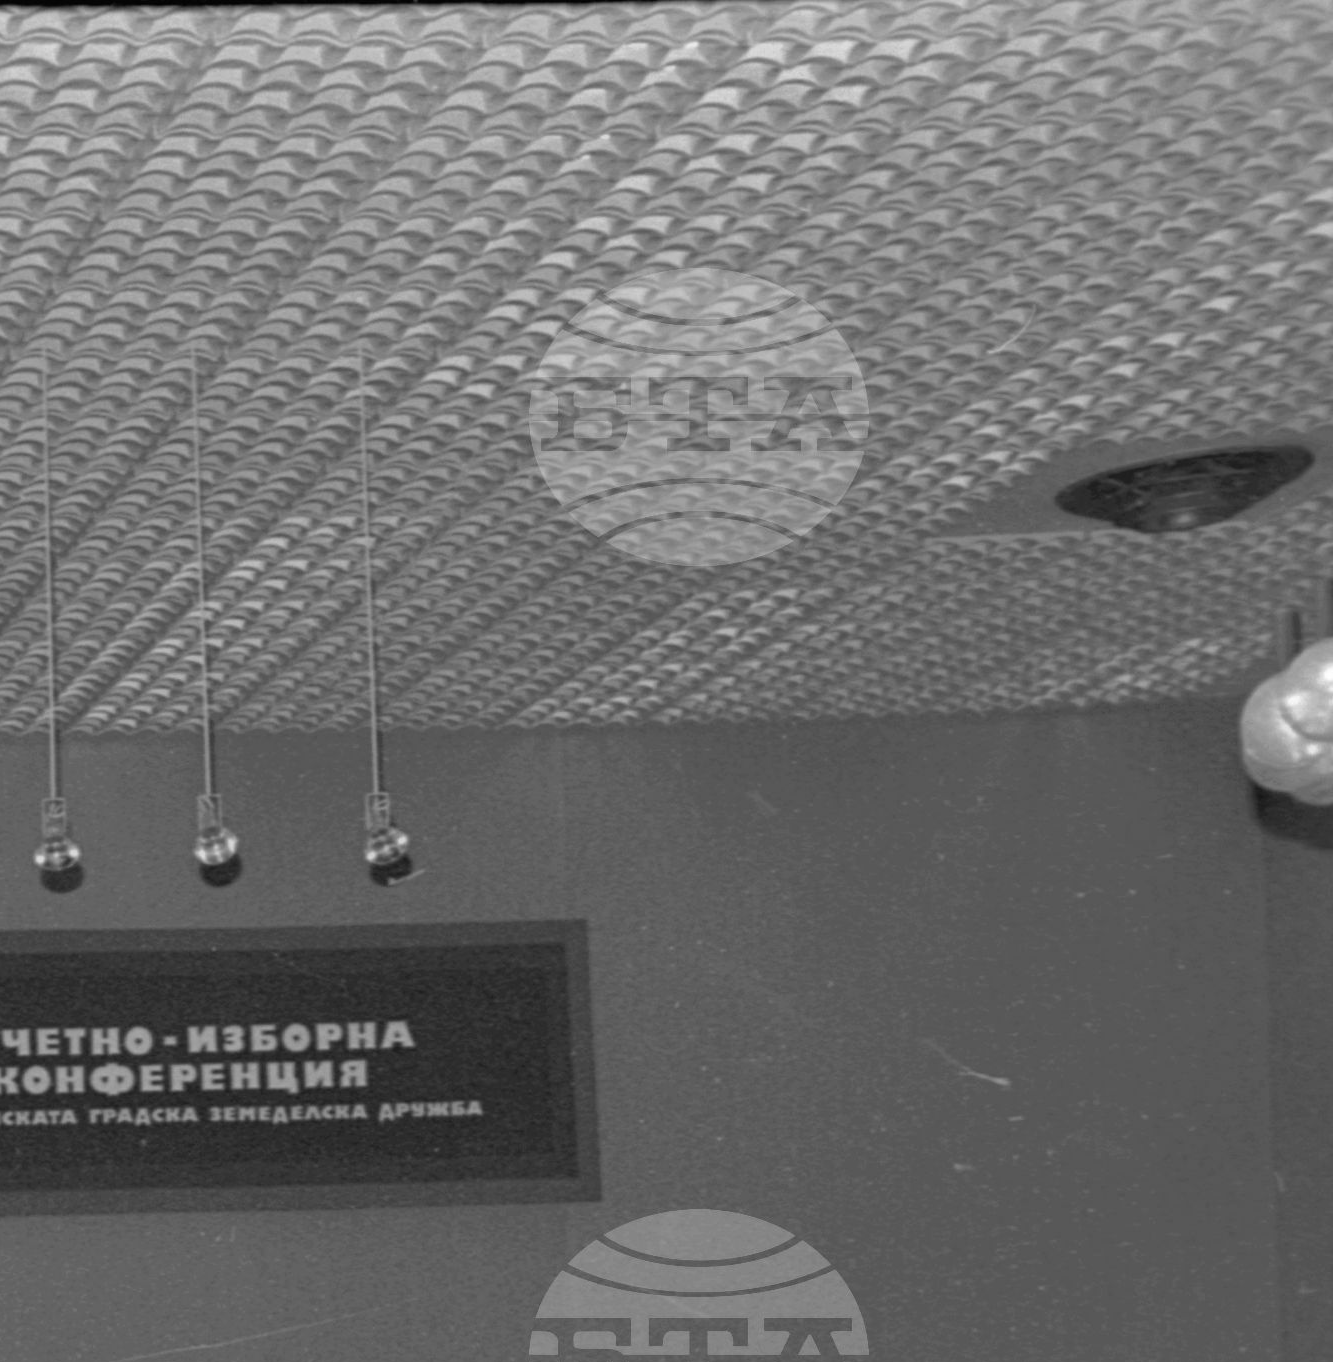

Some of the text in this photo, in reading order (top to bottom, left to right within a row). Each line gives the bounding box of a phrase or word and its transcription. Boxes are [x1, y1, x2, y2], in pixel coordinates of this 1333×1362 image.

[89, 1106, 199, 1126] ГРАДСКА
[209, 1104, 368, 1124] ЗЕМЕДЕЛСКА
[378, 1100, 483, 1122] ДРУЖБА
